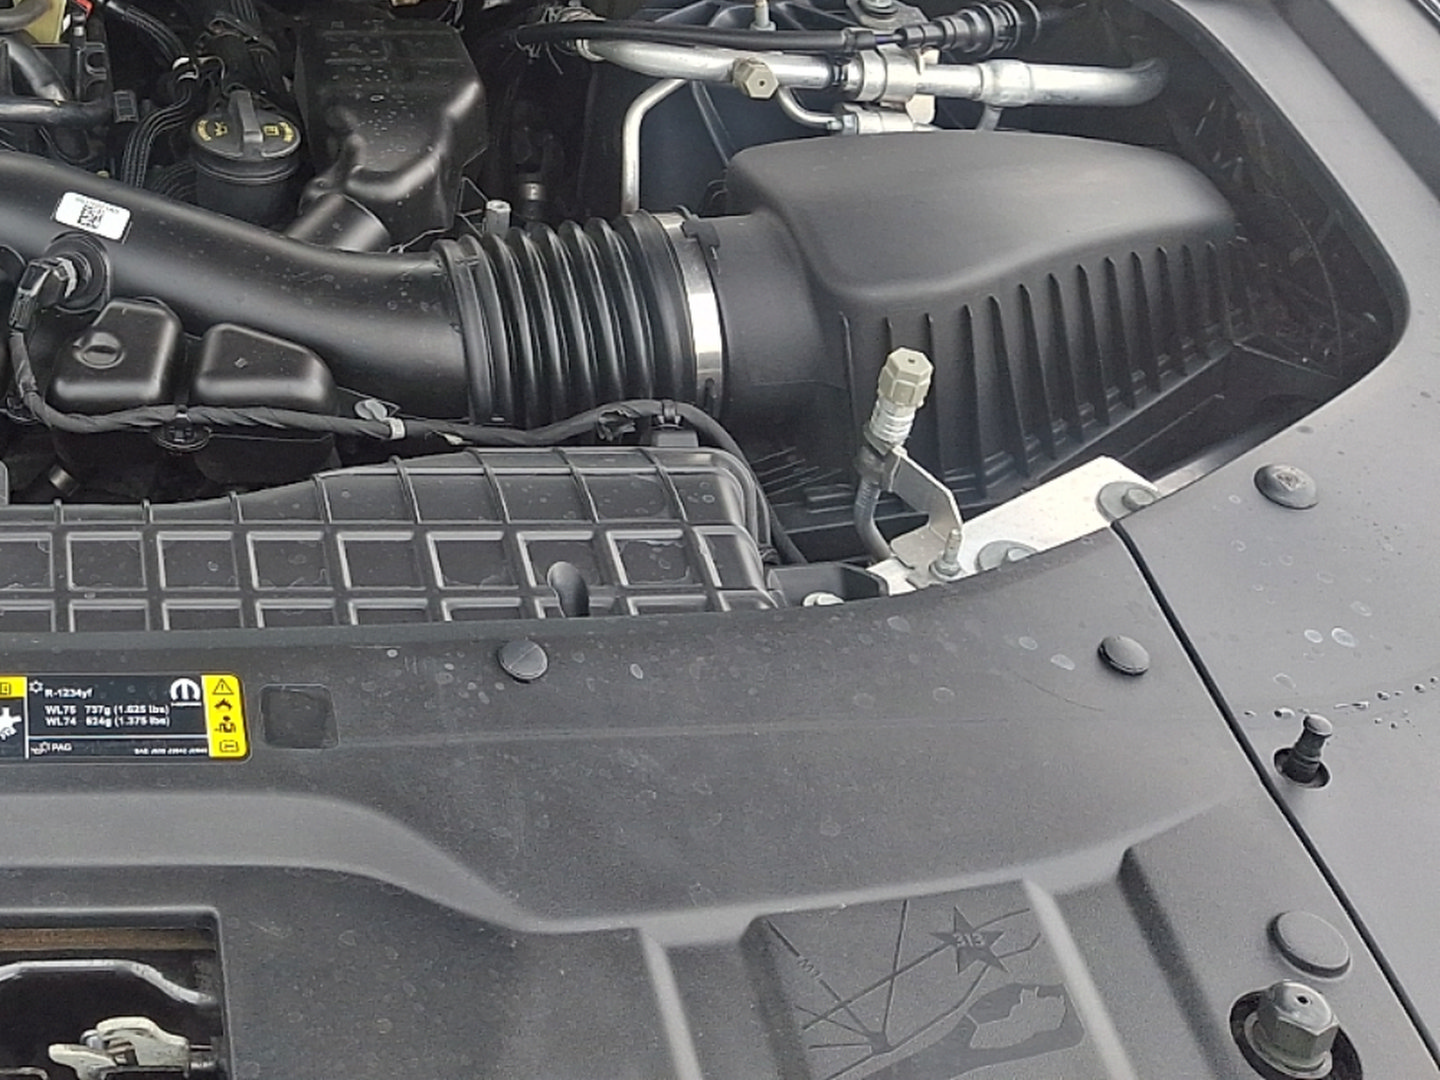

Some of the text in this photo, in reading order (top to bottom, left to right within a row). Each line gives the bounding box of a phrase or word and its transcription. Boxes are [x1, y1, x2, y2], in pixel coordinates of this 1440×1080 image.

[44, 688, 93, 699] R-1234yf
[84, 705, 111, 716] 737g
[148, 704, 170, 716] lbs)
[44, 717, 77, 726] WL74
[149, 716, 170, 727] lbs)
[51, 742, 72, 751] PAG
[953, 933, 985, 948] 313
